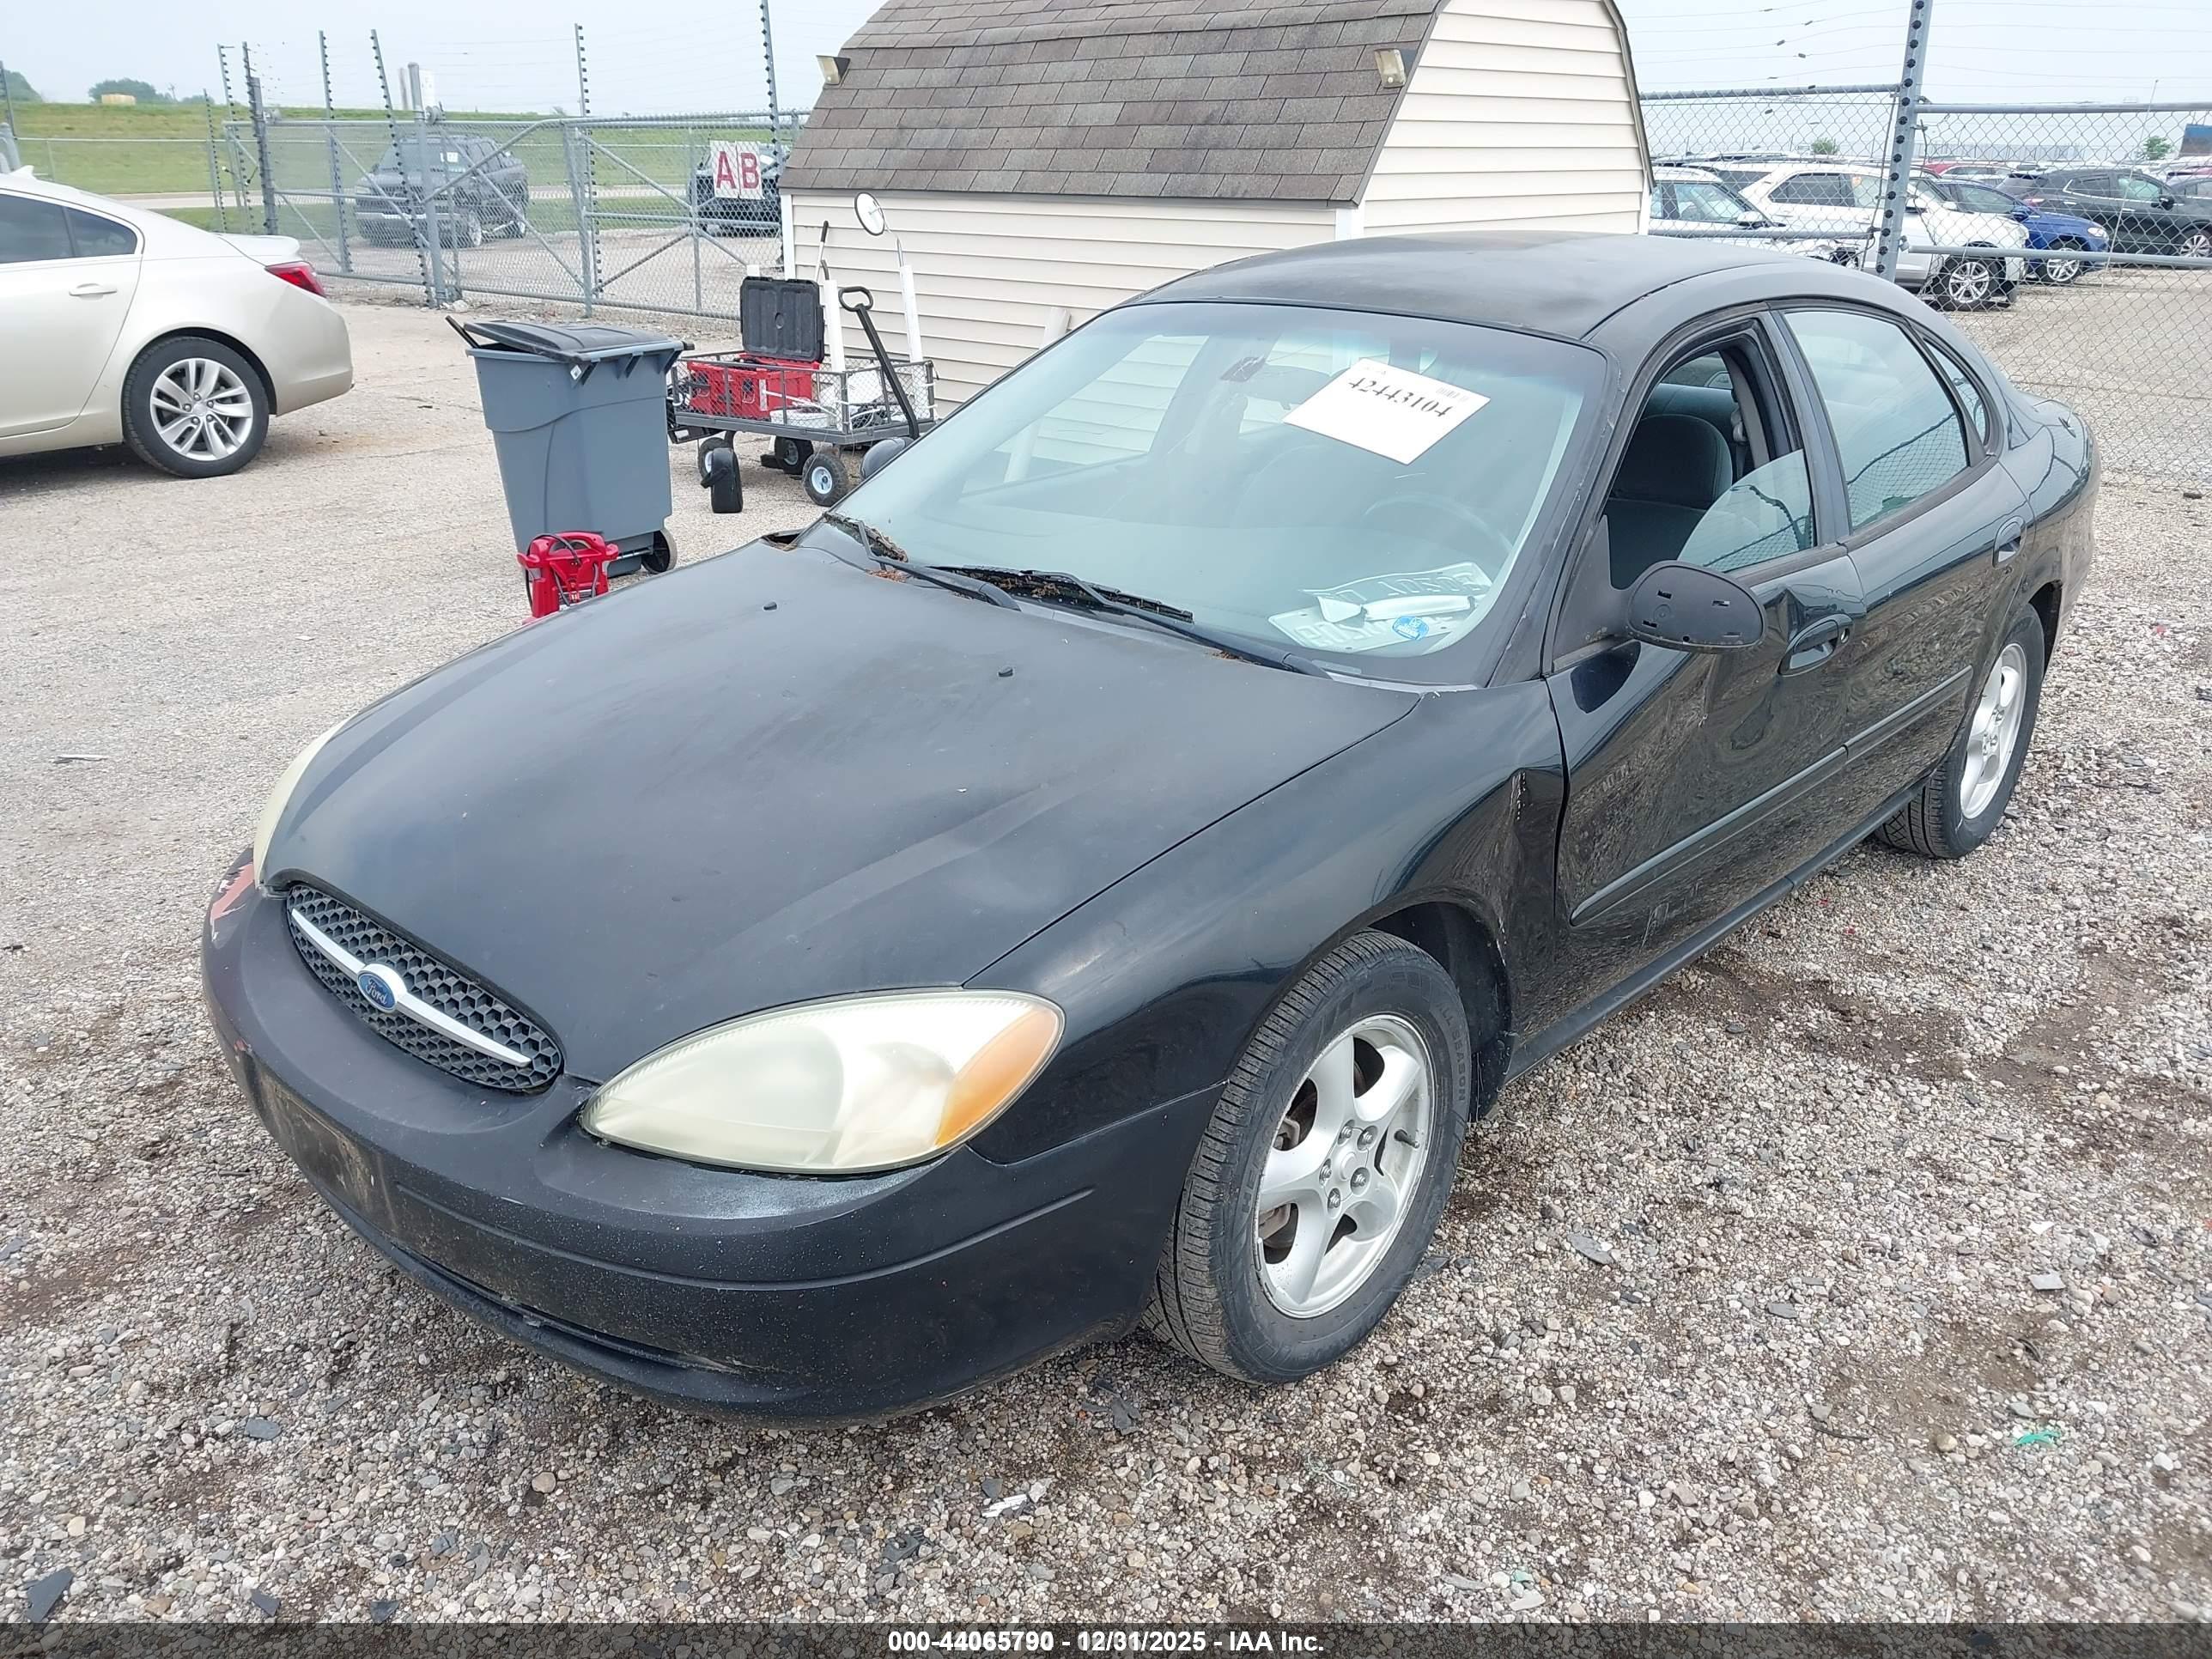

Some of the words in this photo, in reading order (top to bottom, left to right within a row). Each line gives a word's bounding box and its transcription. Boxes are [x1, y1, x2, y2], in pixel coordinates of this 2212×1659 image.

[1349, 378, 1453, 416] 42443104
[366, 978, 388, 1005] Ford
[1451, 1030, 1466, 1102] SEASON
